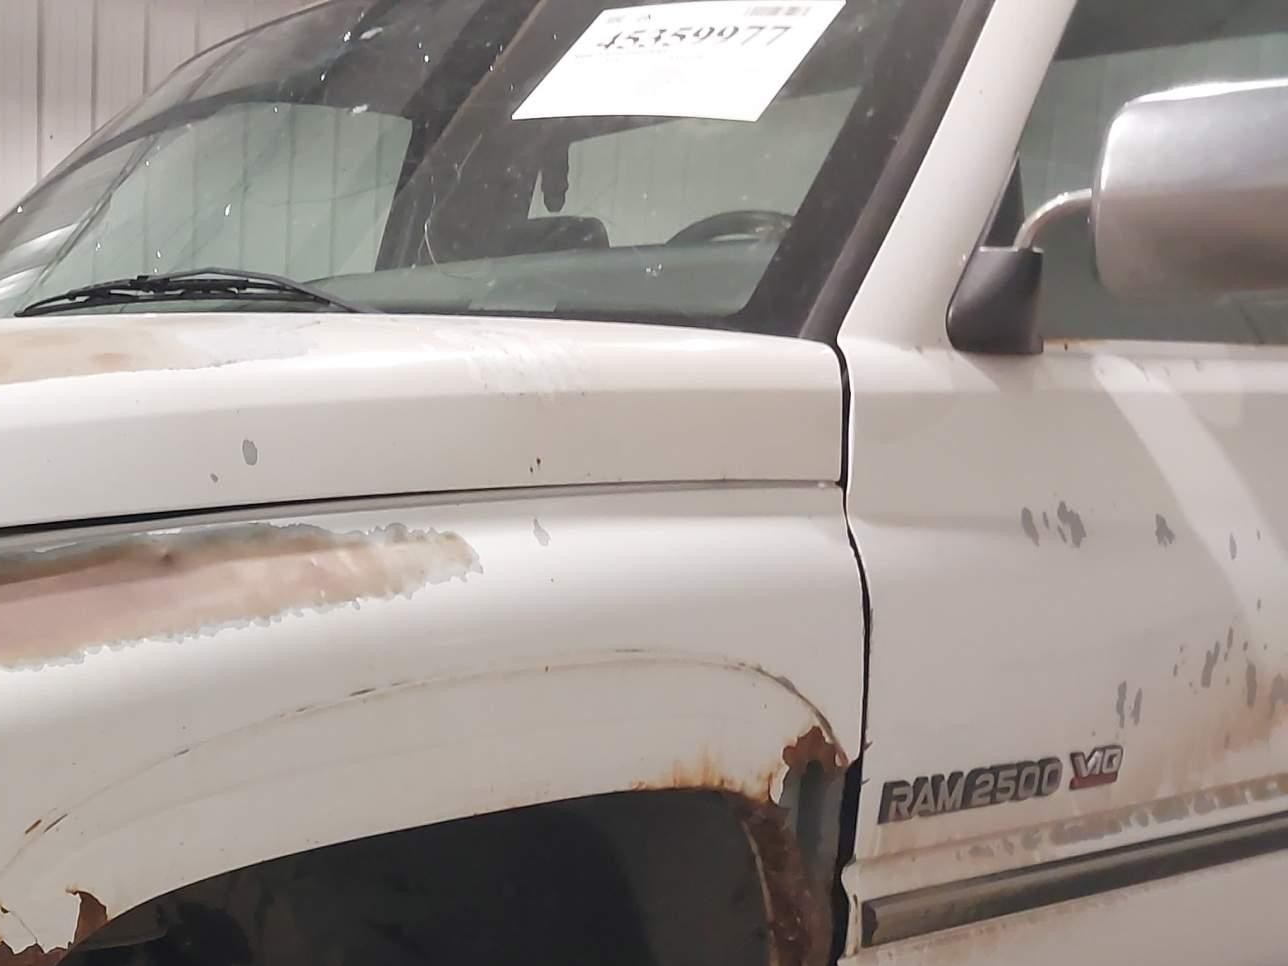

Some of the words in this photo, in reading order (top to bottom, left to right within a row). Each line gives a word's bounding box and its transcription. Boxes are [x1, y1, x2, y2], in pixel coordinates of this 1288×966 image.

[877, 771, 964, 824] RAM
[963, 757, 1062, 806] 2500
[1069, 745, 1123, 784] V10
